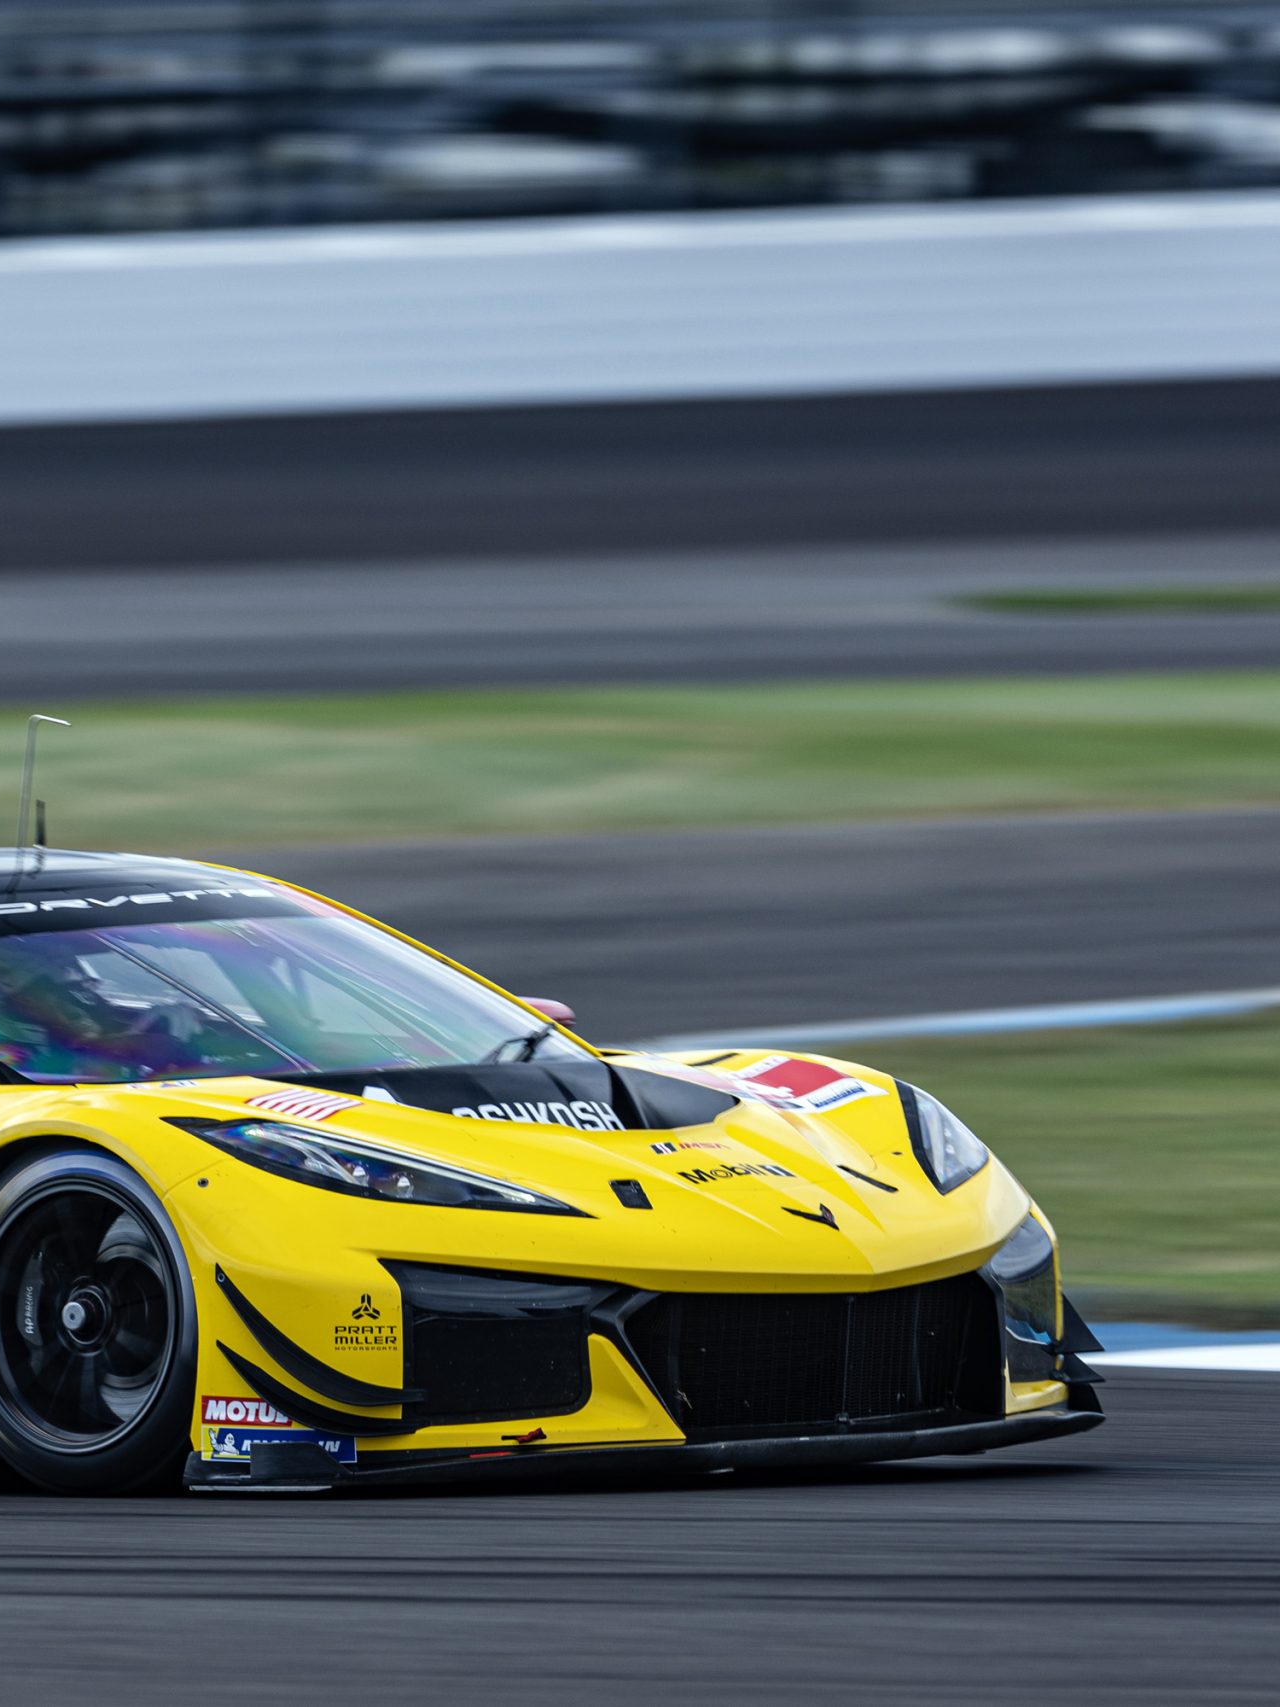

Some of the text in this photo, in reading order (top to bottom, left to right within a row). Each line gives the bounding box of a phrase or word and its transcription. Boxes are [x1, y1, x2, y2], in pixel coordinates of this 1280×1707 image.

[678, 1163, 763, 1184] Mobil
[334, 1325, 398, 1335] PRATT
[334, 1335, 398, 1345] MILLER
